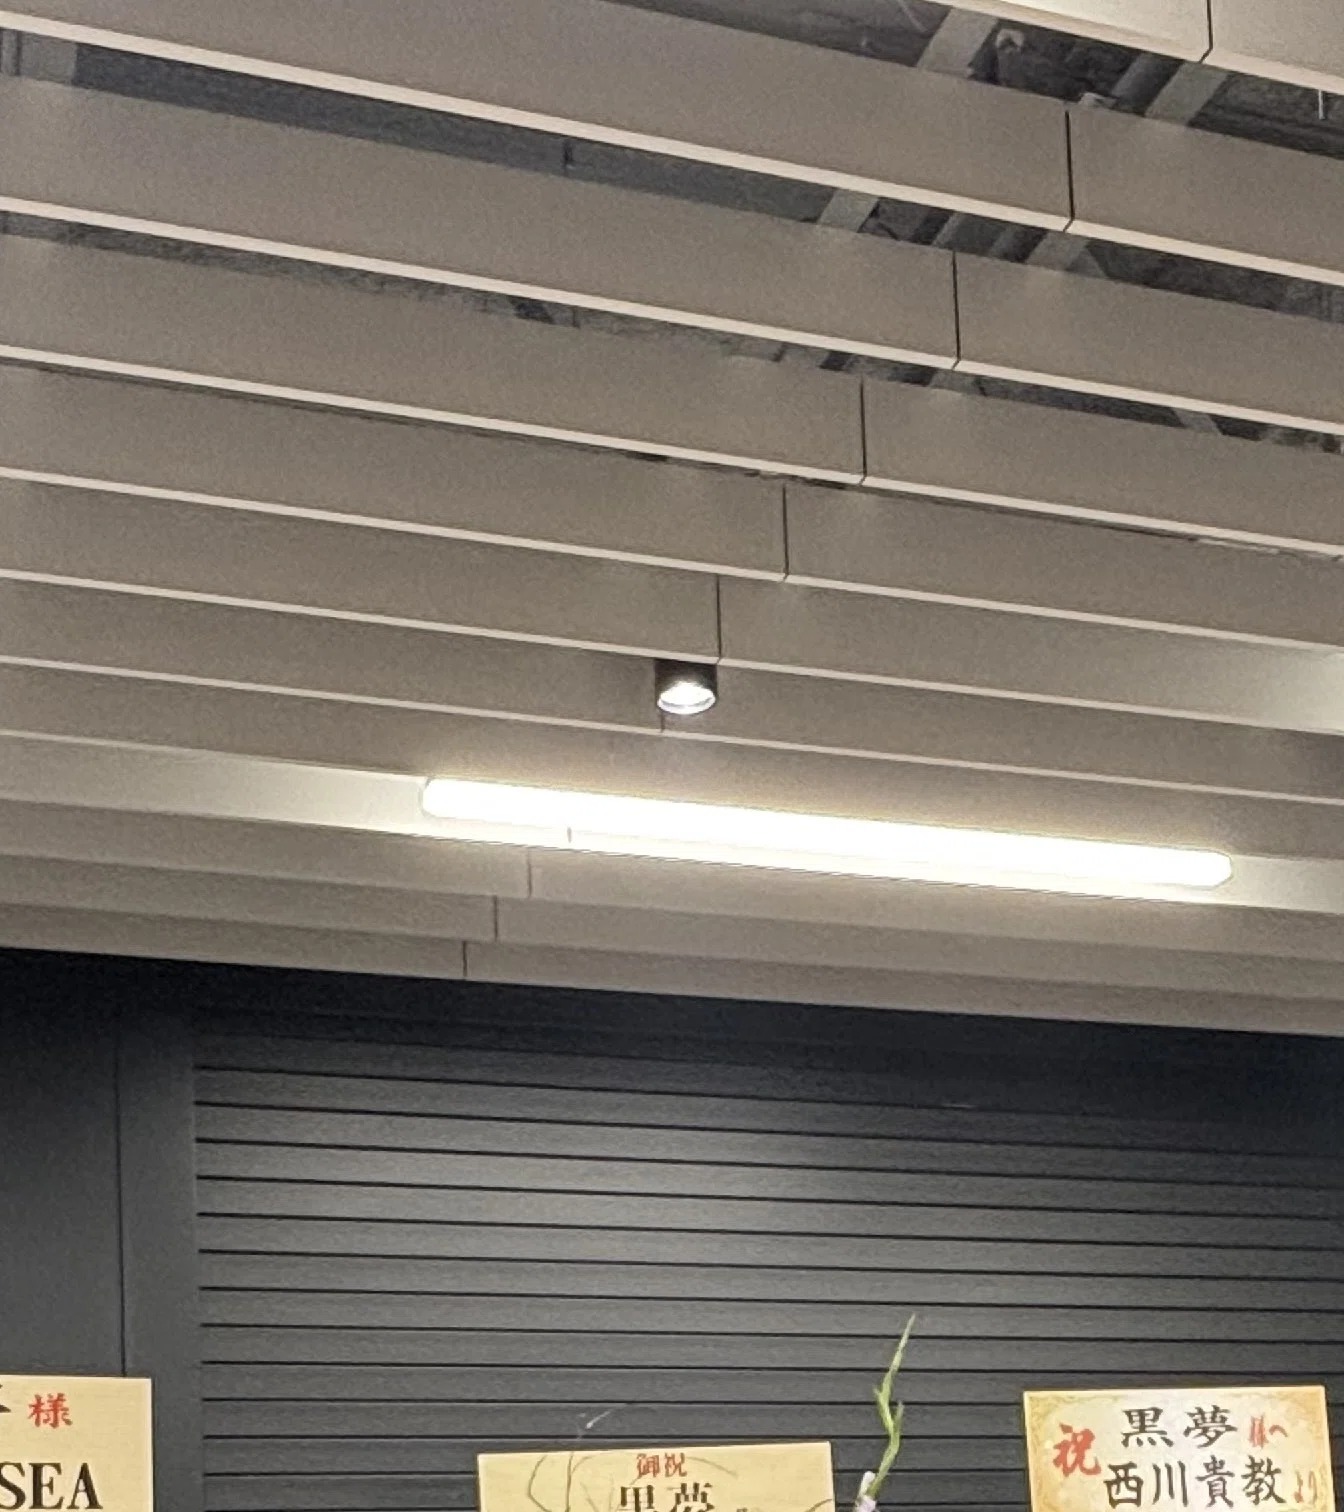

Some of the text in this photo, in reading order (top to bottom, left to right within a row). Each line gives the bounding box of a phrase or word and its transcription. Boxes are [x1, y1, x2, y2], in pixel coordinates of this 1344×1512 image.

[637, 1452, 687, 1477] 御祝
[1053, 1422, 1101, 1477] 祝
[1104, 1454, 1285, 1509] 西川貴教
